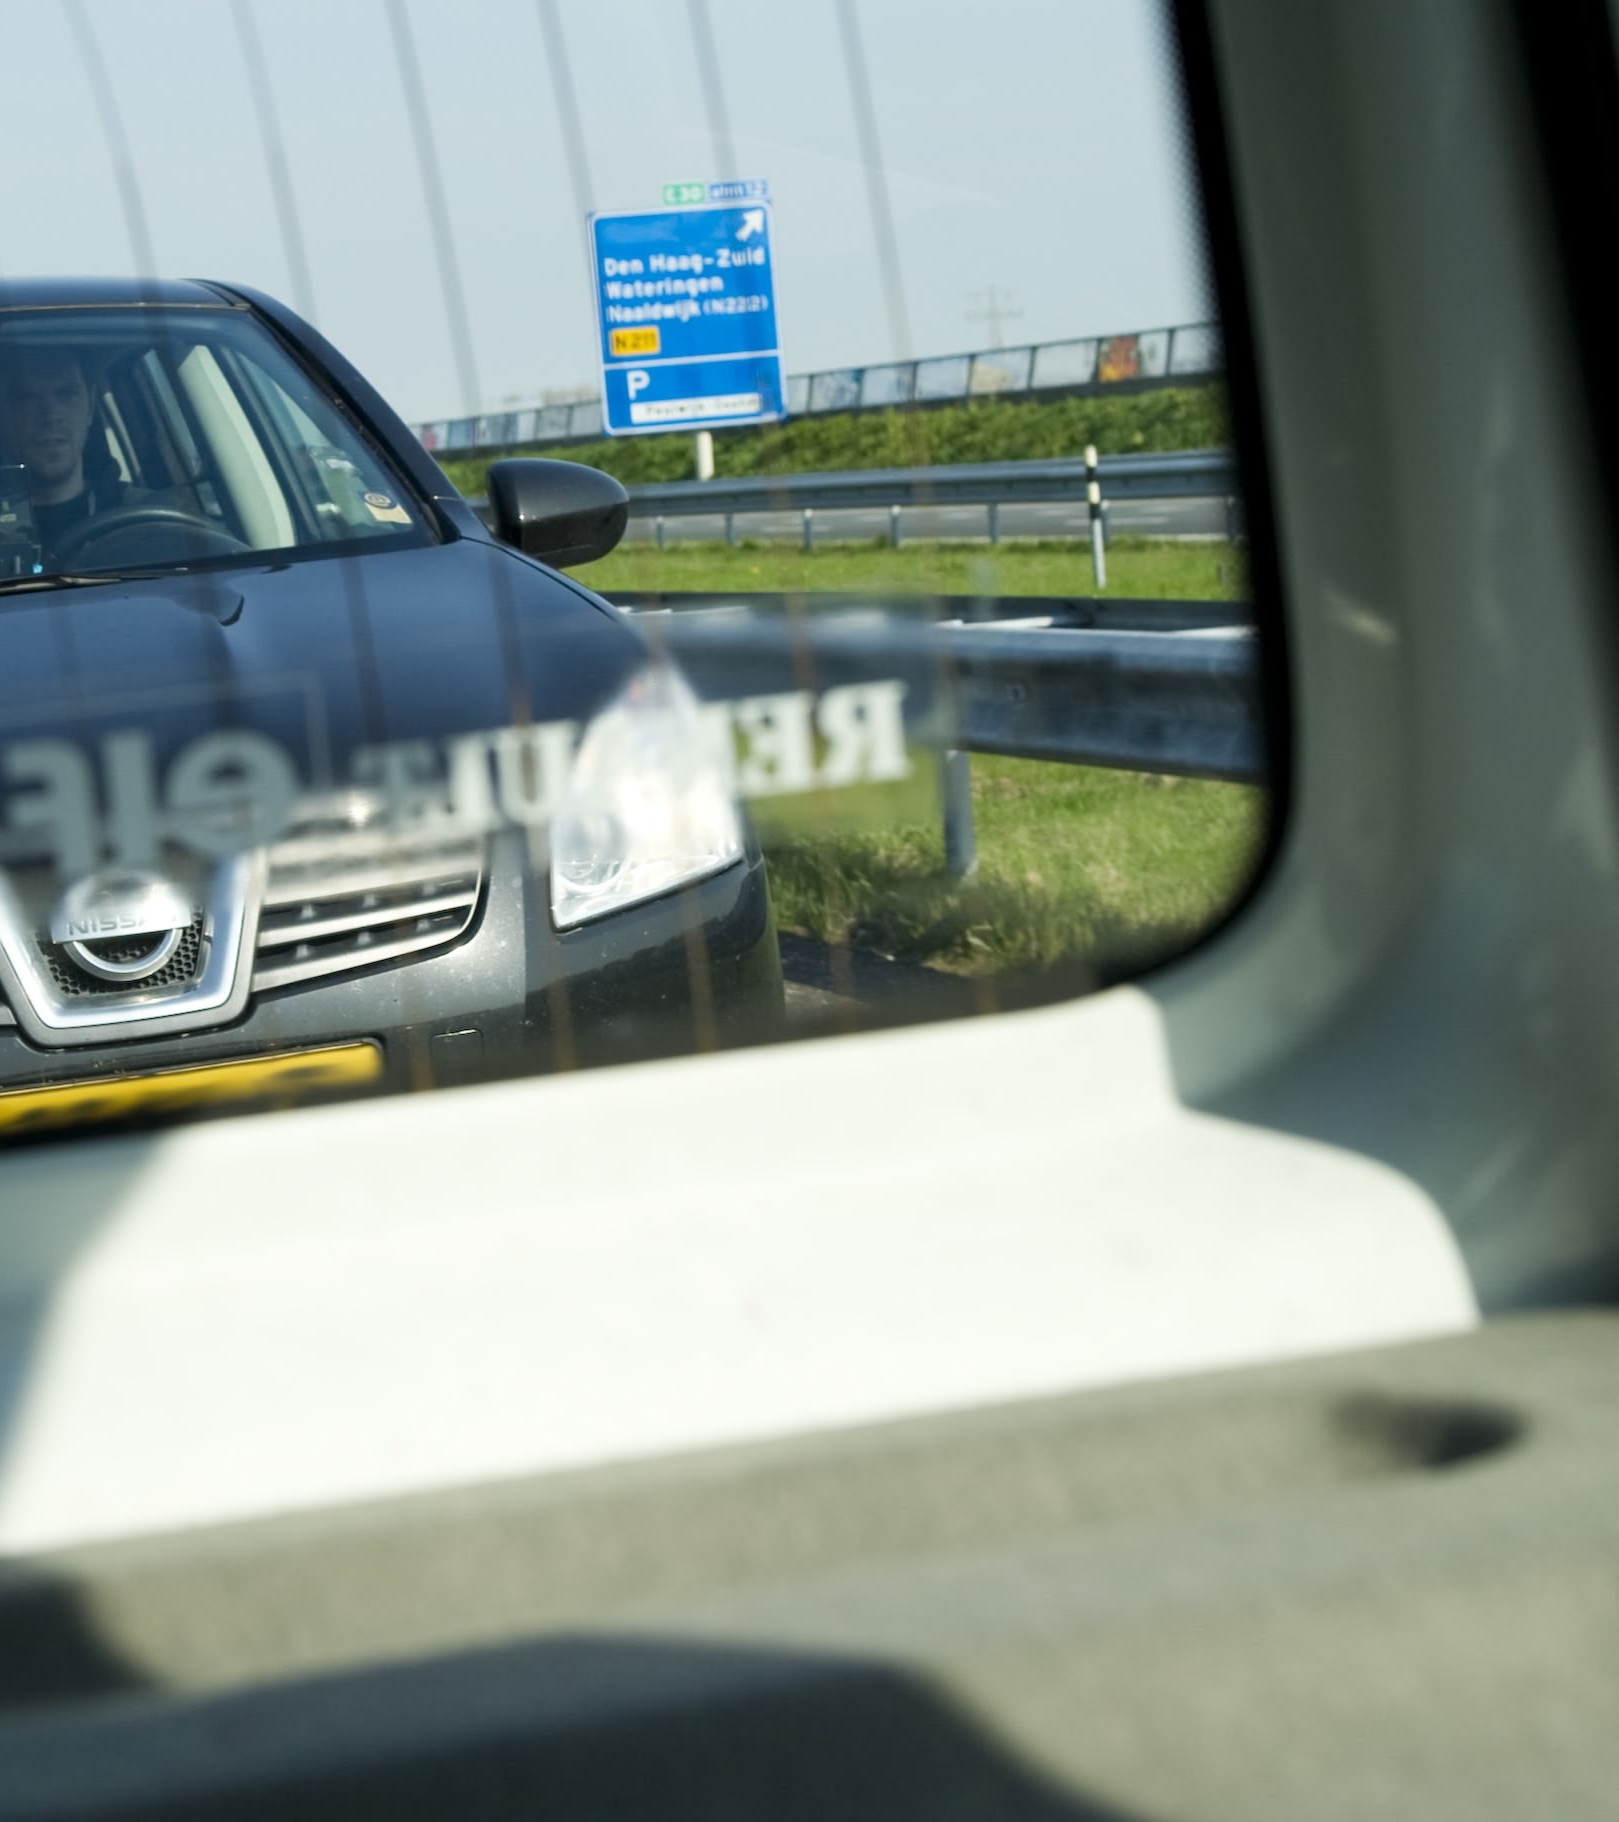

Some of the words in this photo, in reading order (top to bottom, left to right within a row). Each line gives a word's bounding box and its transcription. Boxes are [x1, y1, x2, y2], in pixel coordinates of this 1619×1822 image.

[604, 257, 644, 276] Den
[649, 247, 766, 274] Haag-Zuid
[605, 276, 724, 299] Wateringen
[607, 301, 701, 323] Naaldwijk
[626, 369, 651, 400] P
[67, 911, 178, 936] NISS
